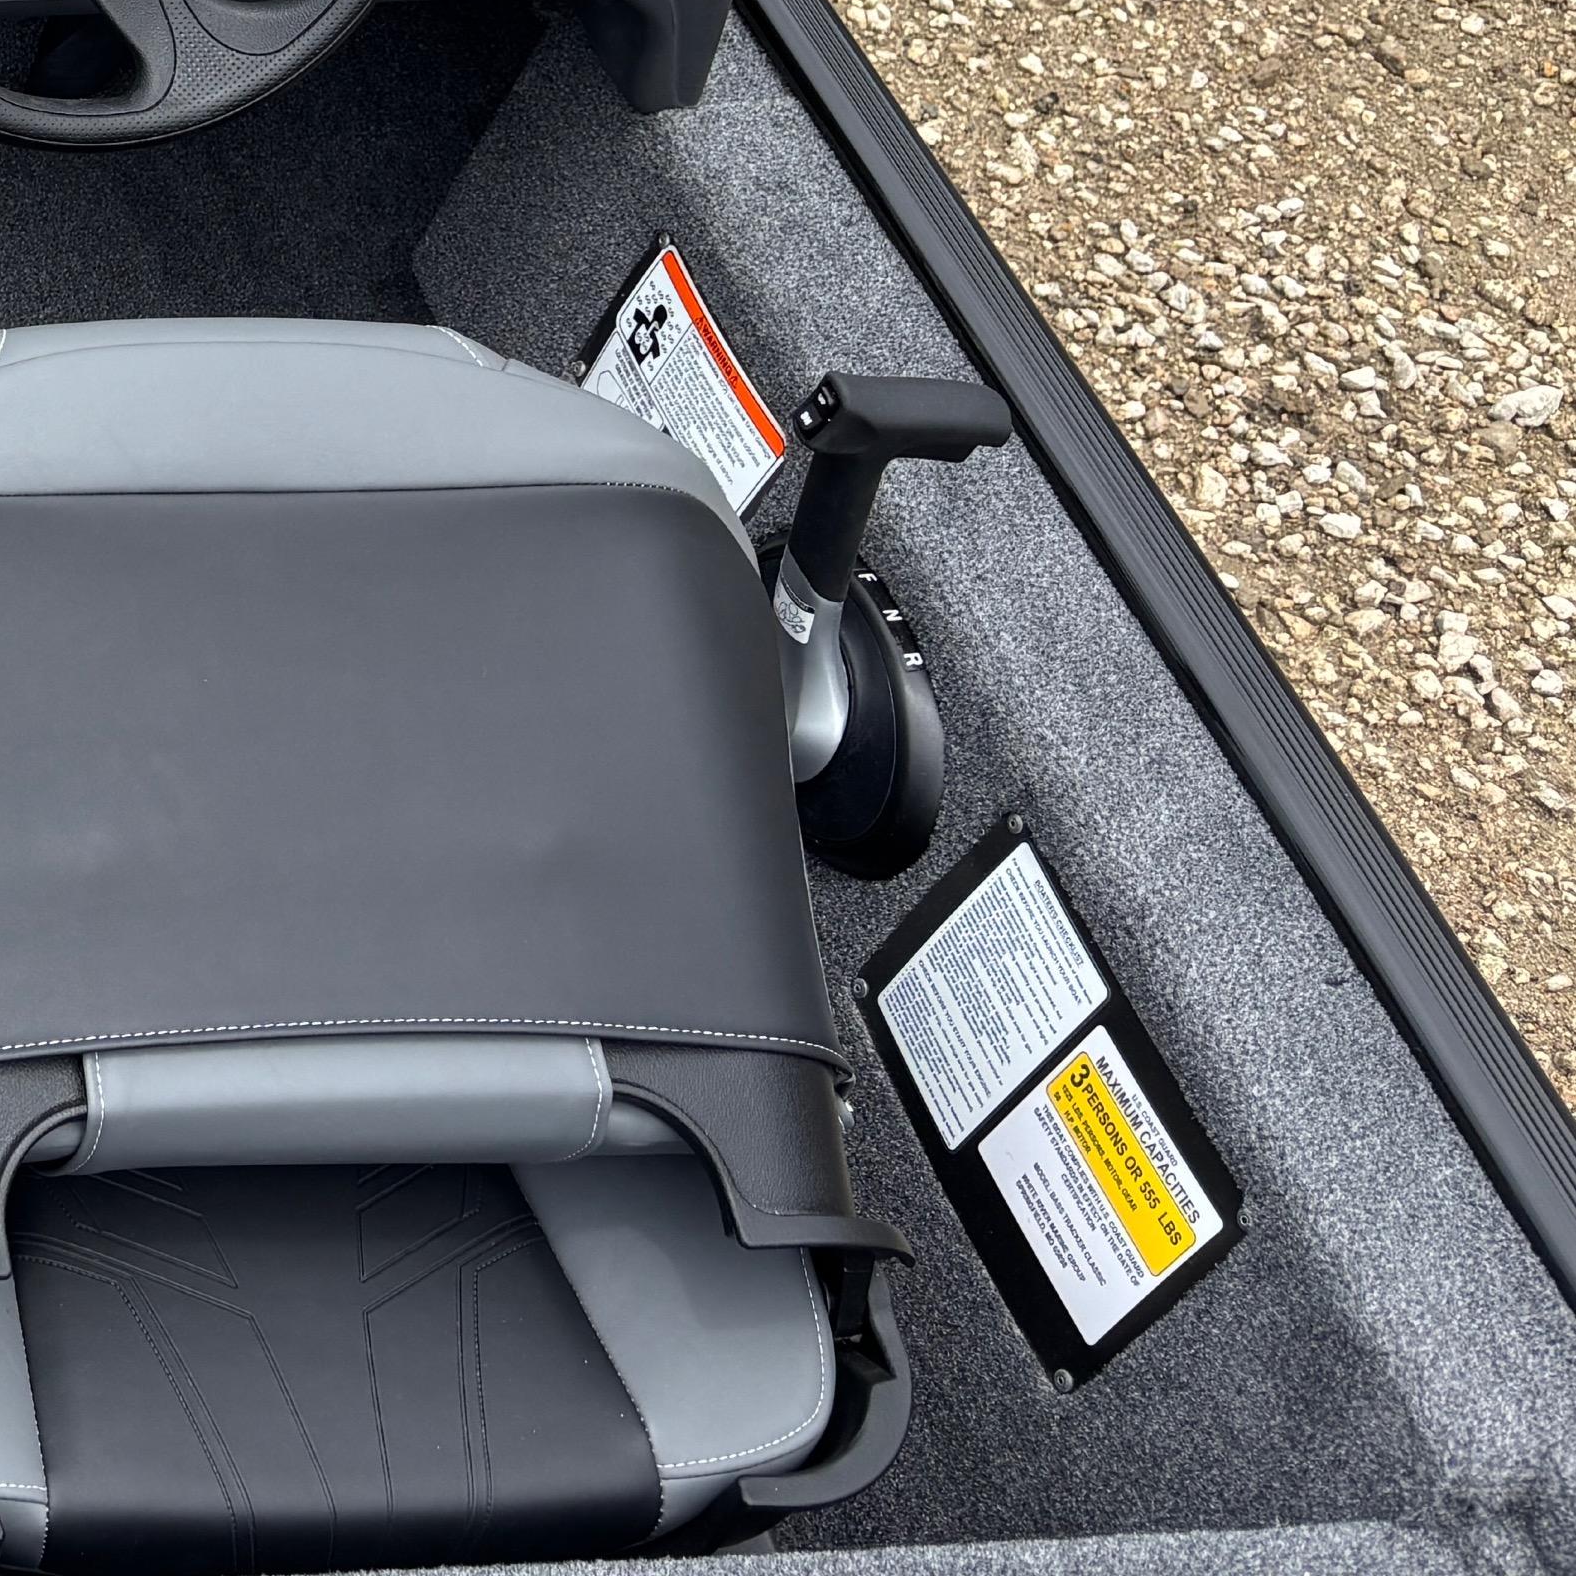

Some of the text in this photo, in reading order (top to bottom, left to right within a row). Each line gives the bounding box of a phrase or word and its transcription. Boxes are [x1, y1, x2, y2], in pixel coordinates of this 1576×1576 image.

[701, 326, 733, 378] WARNING
[858, 573, 878, 582] F
[882, 609, 902, 621] N
[903, 652, 924, 667] R
[1067, 1060, 1183, 1247] 3 PERSONS OR 555 LBS
[1072, 1124, 1092, 1154] MOTOR
[1093, 1055, 1202, 1225] MAXIMUM CAPACITIES
[1140, 1109, 1160, 1138] COAST
[1157, 1137, 1178, 1167] GUARD
[1041, 1103, 1055, 1124] THIS
[1062, 1142, 1090, 1185] COMPLIES
[1107, 1220, 1127, 1249] COAST
[1123, 1247, 1145, 1279] GUARD
[1120, 1187, 1138, 1212] GEAR
[1048, 1190, 1065, 1215] BASS
[1061, 1213, 1087, 1252] TRACKER
[1106, 1235, 1120, 1254] THE
[1115, 1251, 1133, 1276] DATE
